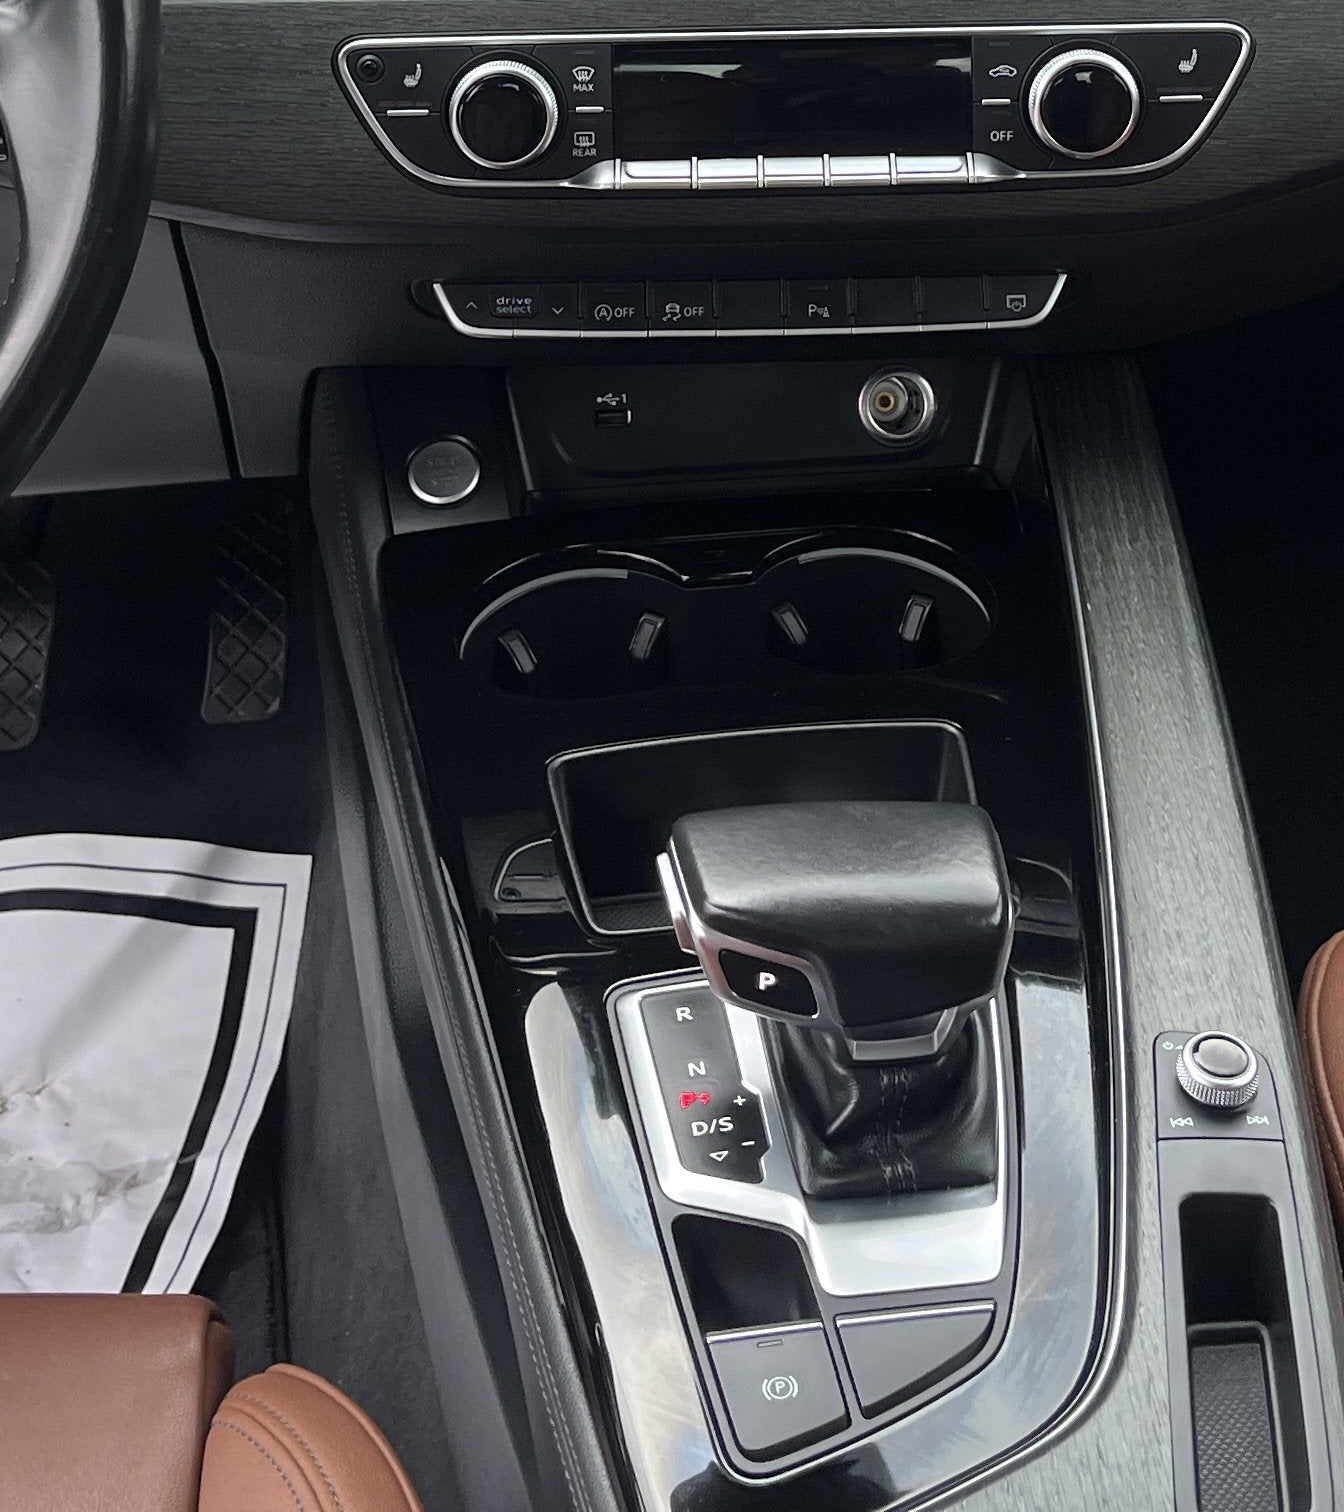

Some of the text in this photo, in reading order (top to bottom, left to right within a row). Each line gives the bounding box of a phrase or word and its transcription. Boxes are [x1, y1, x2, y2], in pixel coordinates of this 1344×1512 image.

[572, 80, 595, 92] MAX
[989, 130, 1014, 142] OFF
[572, 147, 597, 158] REAR
[496, 296, 533, 307] drive
[496, 304, 532, 314] select
[613, 306, 635, 319] OFF
[683, 306, 705, 318] OFF
[758, 971, 777, 991] P
[675, 1006, 694, 1022] R
[687, 1060, 707, 1077] N
[690, 1116, 735, 1137] D/S
